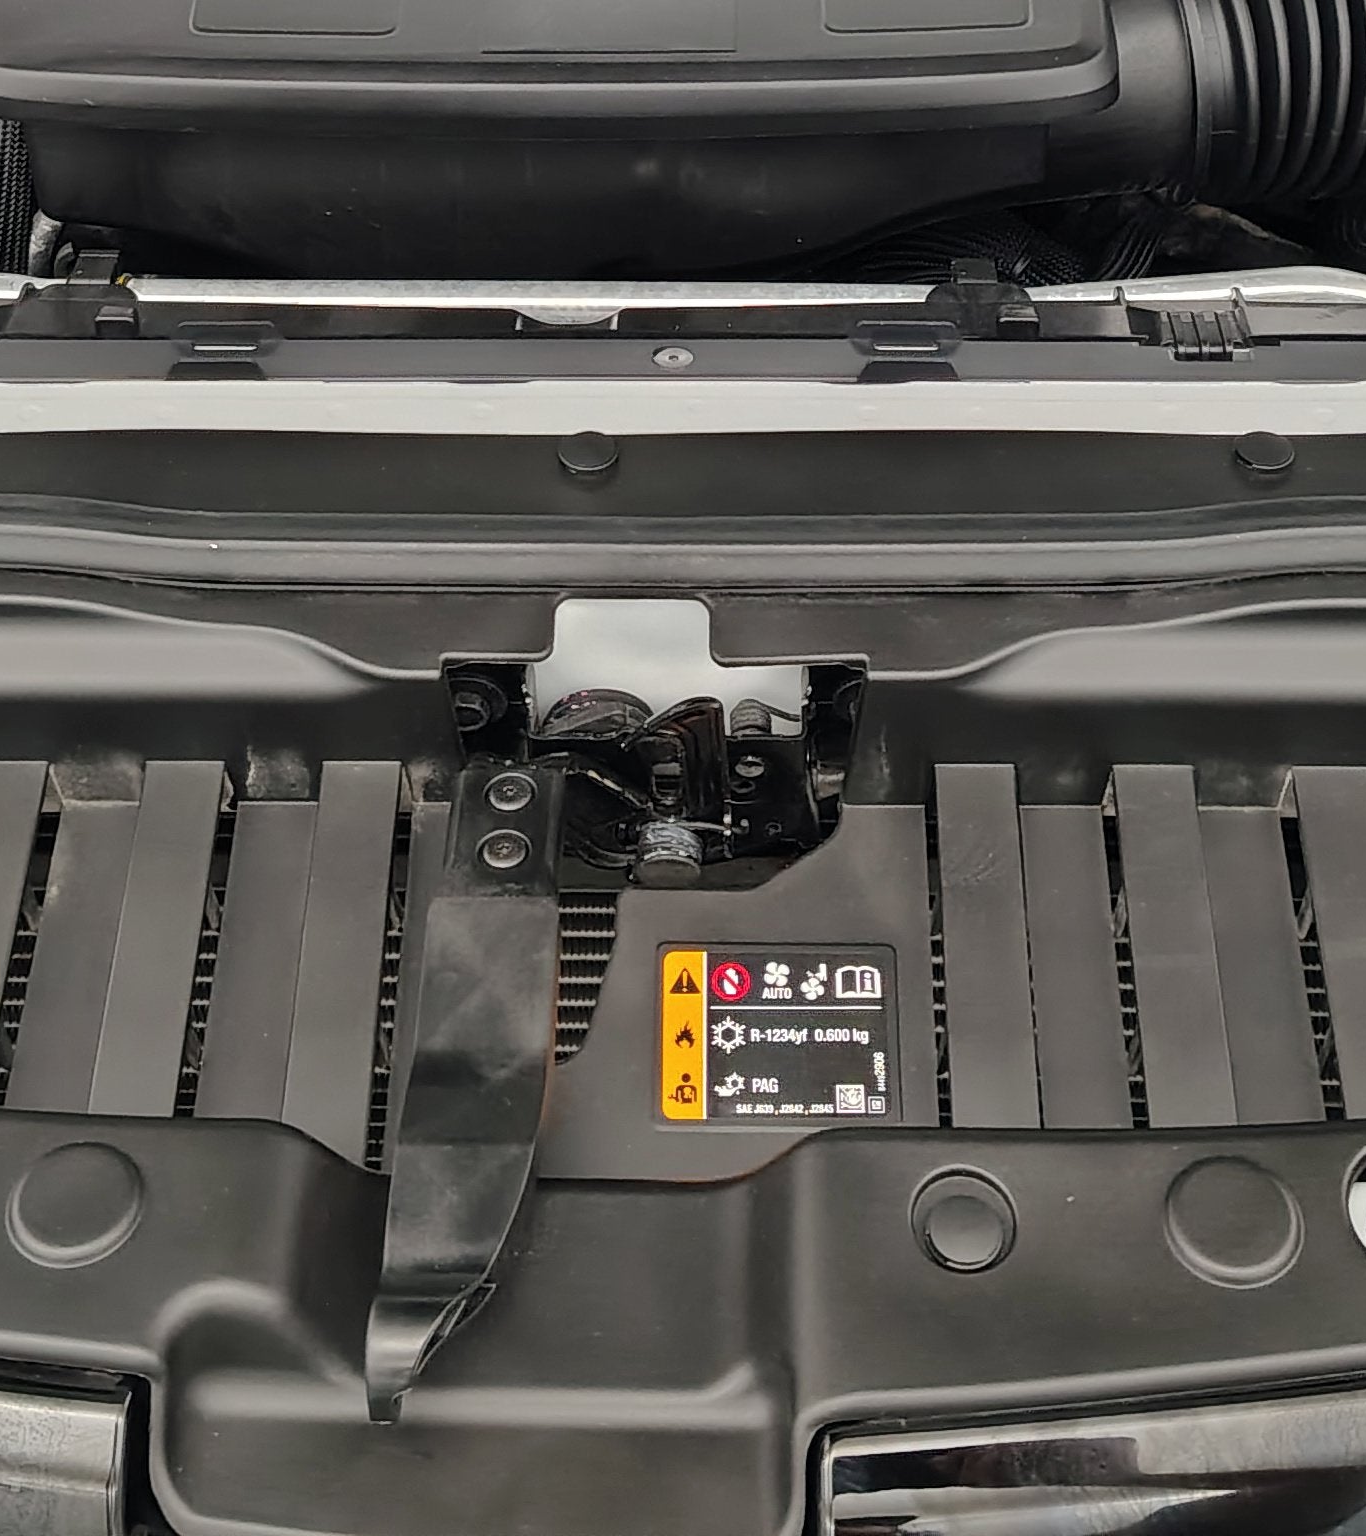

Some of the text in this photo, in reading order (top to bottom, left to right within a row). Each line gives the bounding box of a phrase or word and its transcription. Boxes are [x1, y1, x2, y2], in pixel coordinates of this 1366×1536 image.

[762, 987, 792, 1000] AUTO
[750, 1028, 869, 1045] R-1234yf 0.600 kg
[752, 1078, 779, 1093] PAG
[736, 1103, 753, 1114] SAE
